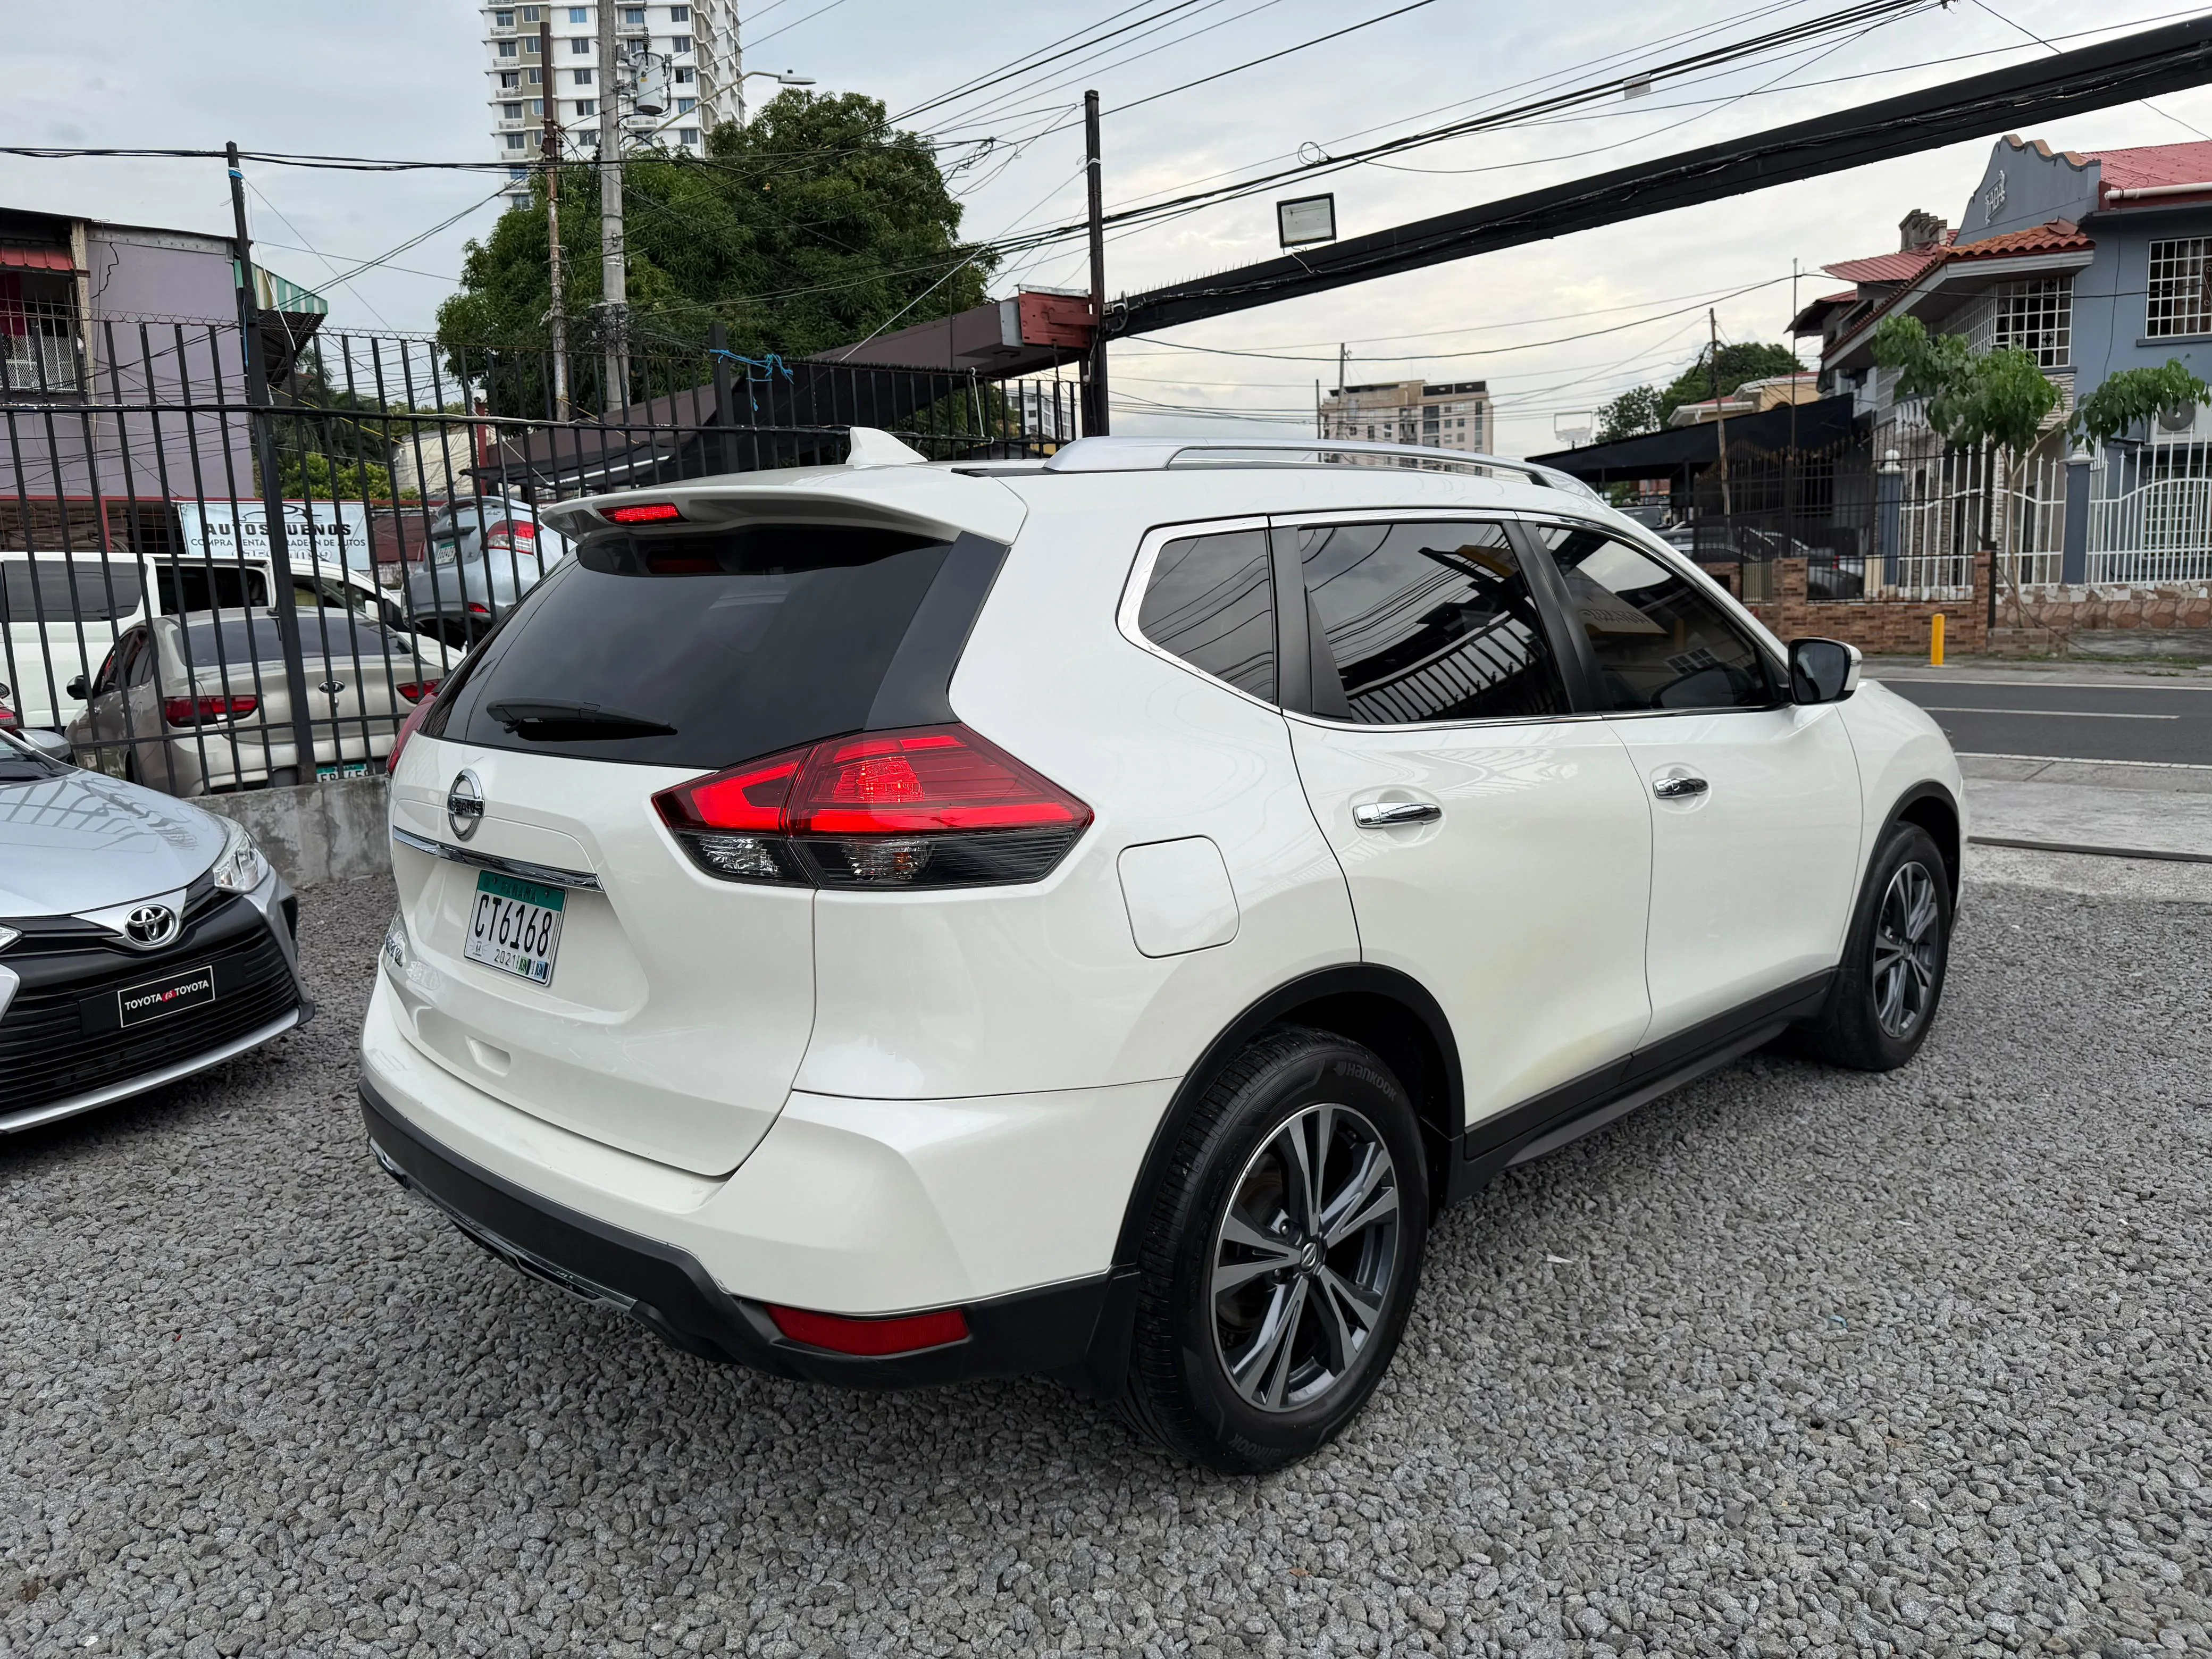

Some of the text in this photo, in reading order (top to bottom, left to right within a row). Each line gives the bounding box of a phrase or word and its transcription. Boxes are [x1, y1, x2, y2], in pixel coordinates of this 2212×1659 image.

[206, 523, 351, 535] AUOS UENOS
[238, 538, 267, 547] ENTA
[338, 539, 366, 547] UTOS
[475, 894, 552, 958] CT6168
[494, 948, 516, 968] 2021
[124, 979, 210, 1010] TOYOTA es TOYOTA
